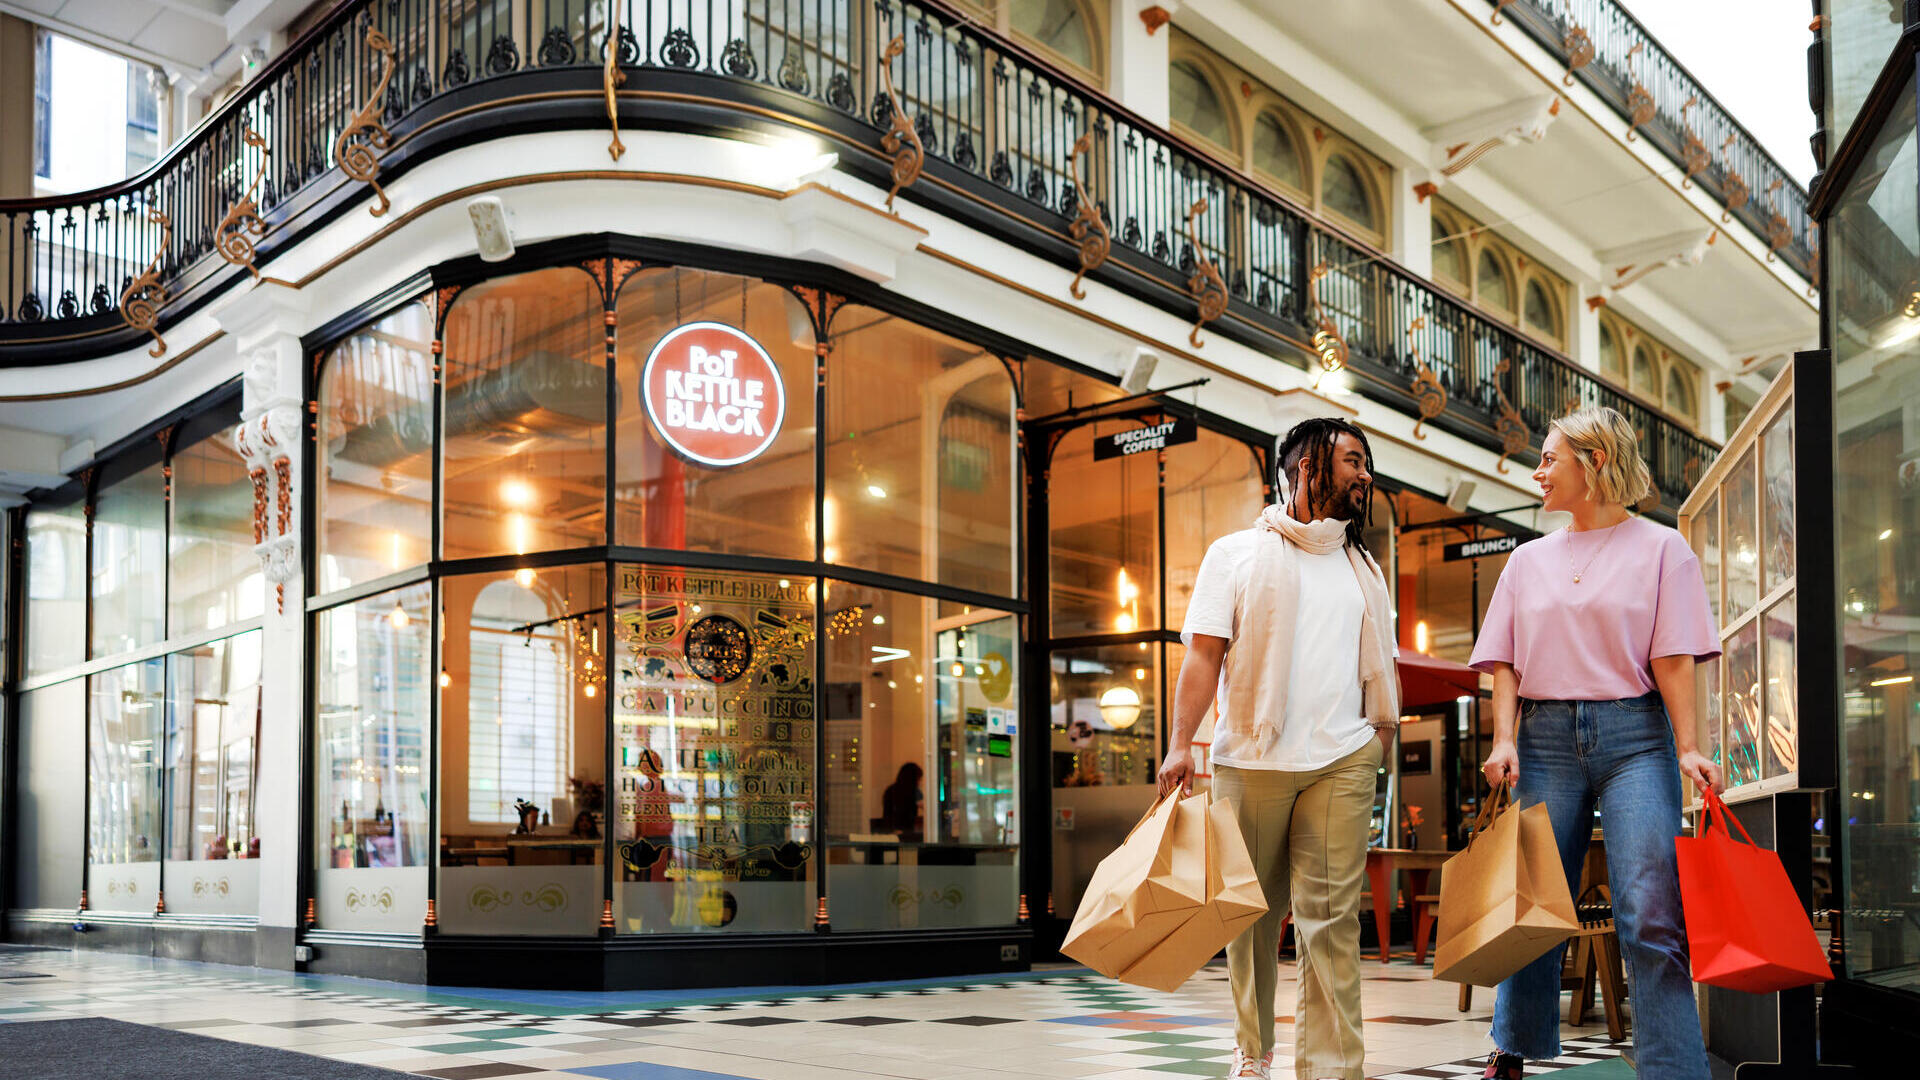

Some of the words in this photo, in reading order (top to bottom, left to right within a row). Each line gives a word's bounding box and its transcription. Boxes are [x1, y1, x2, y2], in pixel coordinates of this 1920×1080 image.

[665, 370, 764, 409] KETTLE
[665, 398, 765, 437] BLACK
[1113, 422, 1176, 446] SPECIALITY
[1122, 436, 1166, 455] COFFEE
[1460, 536, 1517, 557] BRUNCH
[623, 573, 662, 592] POT
[666, 577, 744, 598] KETTLE
[749, 583, 810, 601] BLACK
[694, 825, 741, 844] TEA
